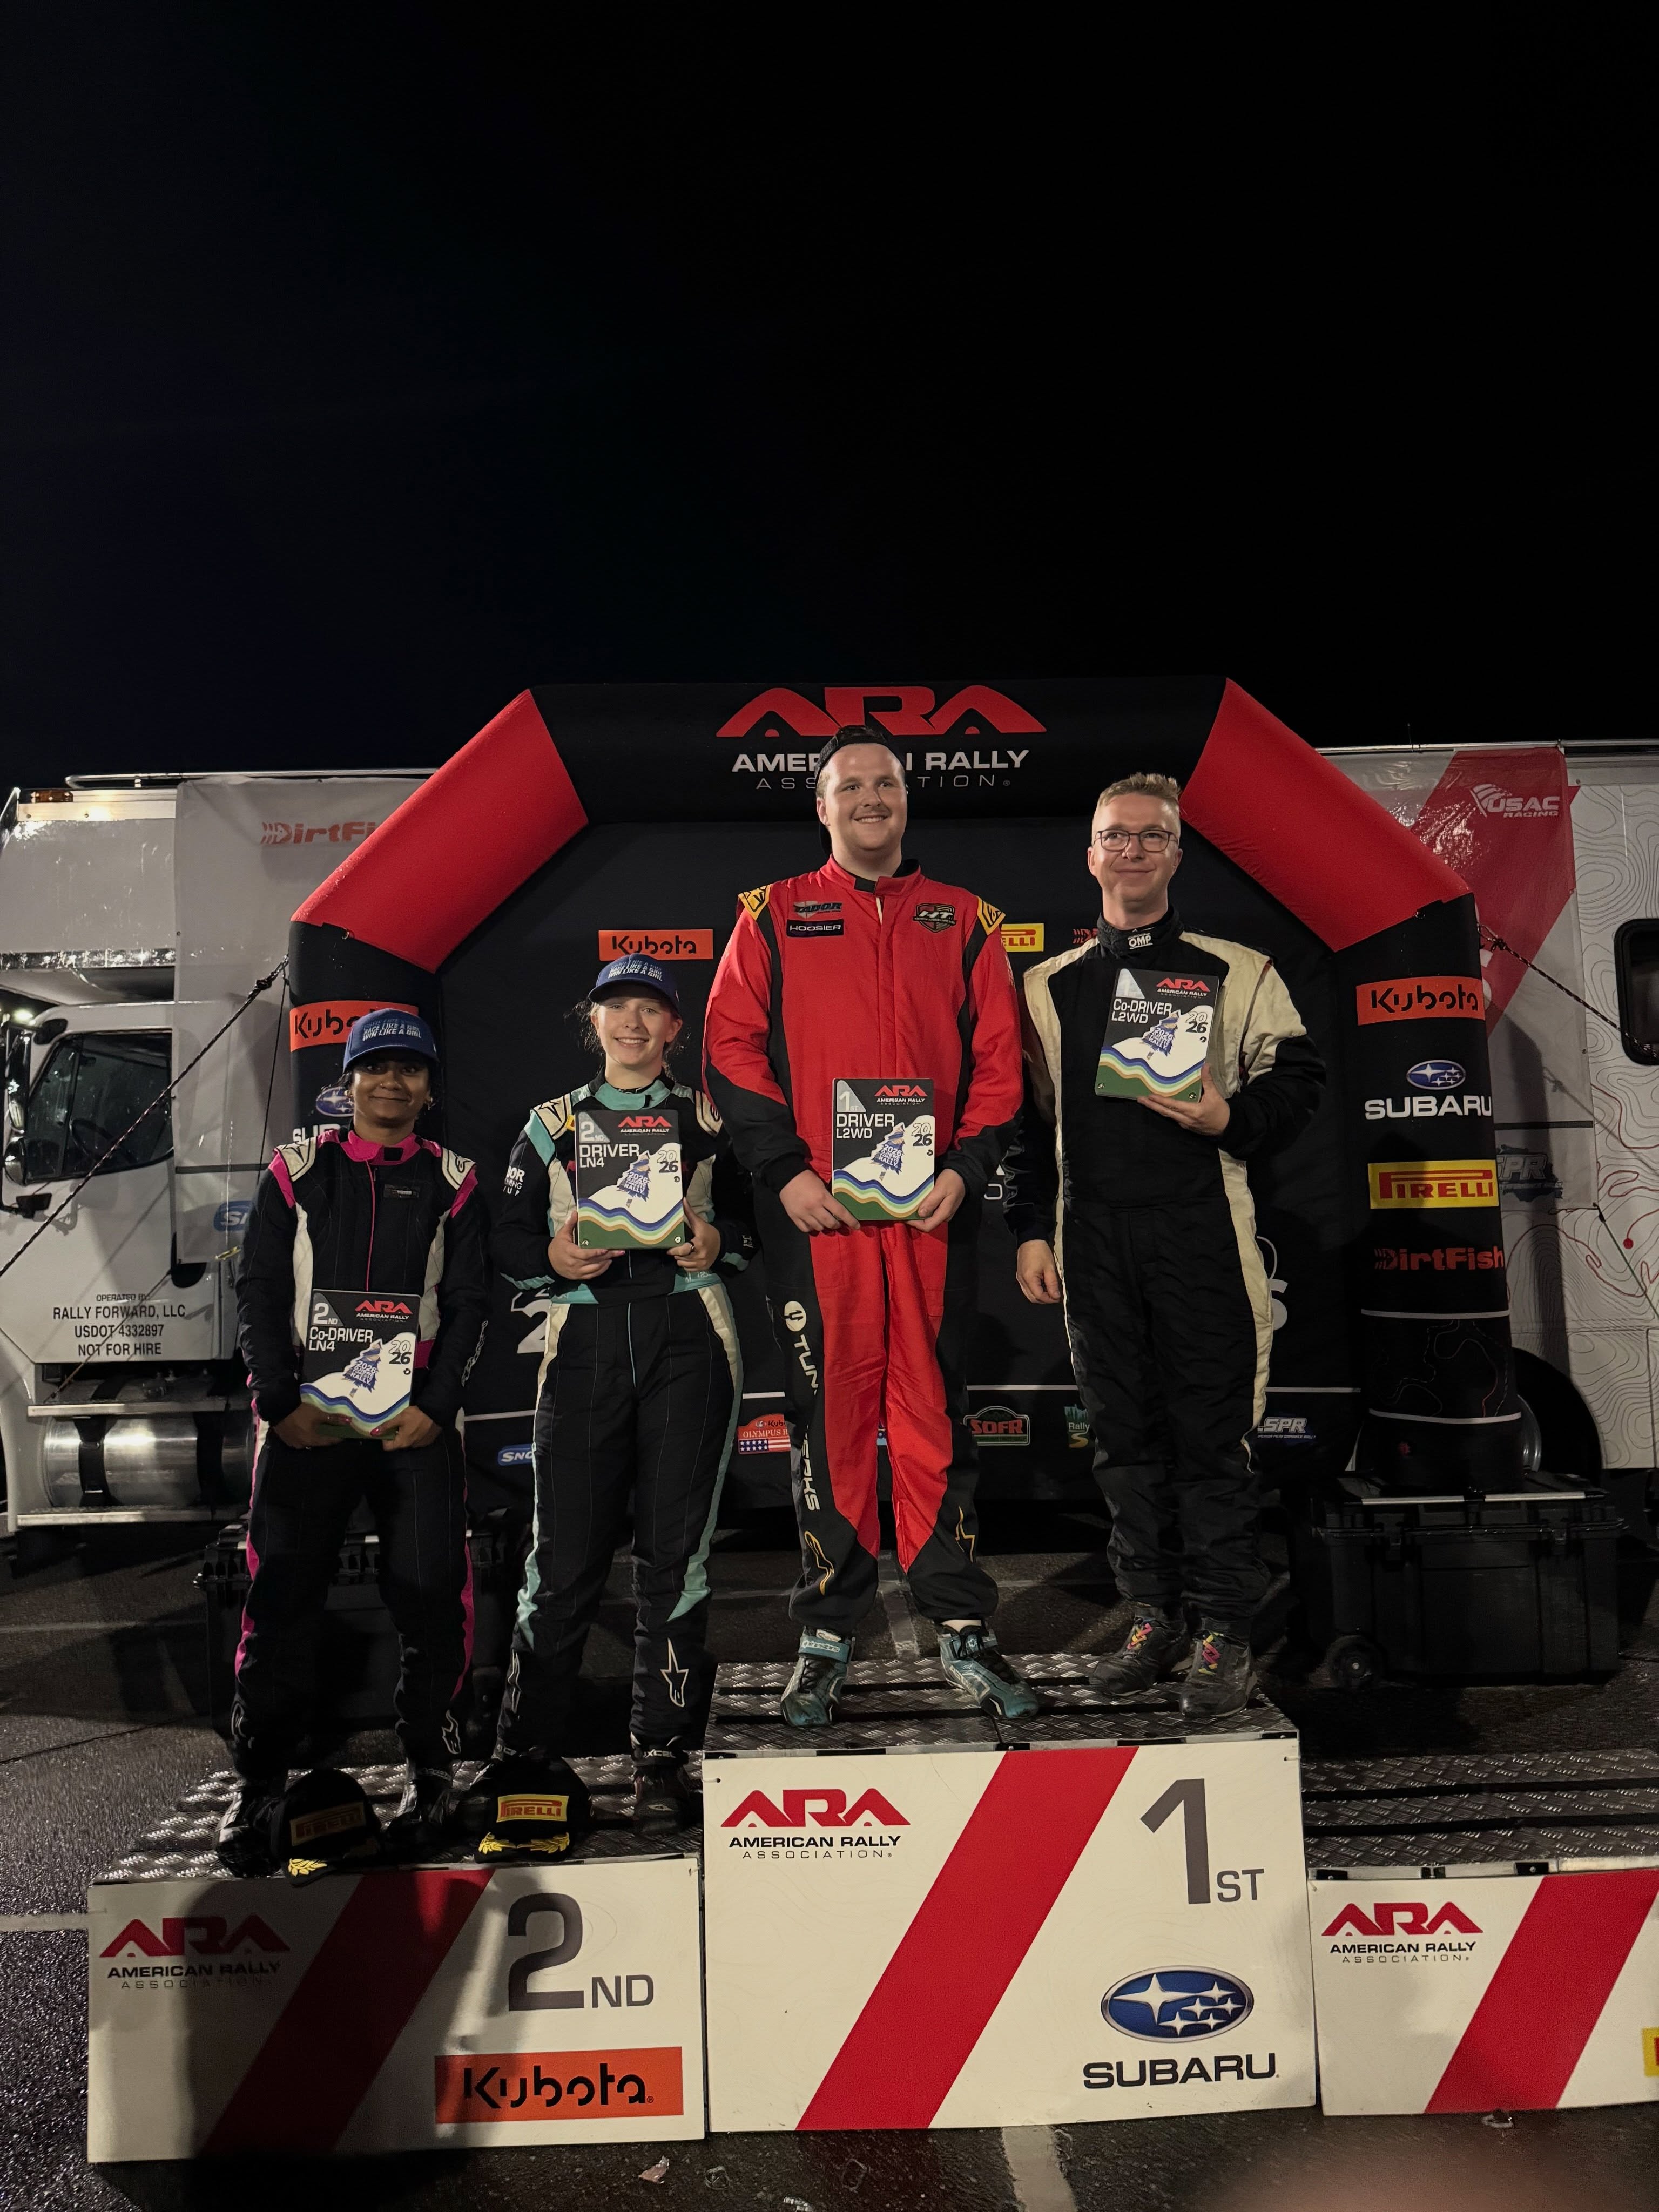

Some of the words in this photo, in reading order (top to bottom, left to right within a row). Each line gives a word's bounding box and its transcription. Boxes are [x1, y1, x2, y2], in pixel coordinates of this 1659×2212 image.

[716, 685, 1047, 738] ARA
[926, 750, 1029, 770] RALLY
[1487, 796, 1560, 812] USAC
[260, 821, 376, 844] DirtFi
[612, 935, 697, 954] Kubota
[1128, 935, 1152, 948] OMP
[1156, 977, 1210, 992] ARA
[1371, 984, 1479, 1013] Kubota
[1113, 999, 1172, 1015] Co-DRIVER
[1111, 1011, 1148, 1024] L2WD
[1186, 1011, 1208, 1023] 20
[1185, 1021, 1208, 1034] 26
[874, 1085, 928, 1097] ARA
[1364, 1095, 1492, 1120] SUBARU
[617, 1116, 673, 1128] ARA
[837, 1114, 895, 1127] DRIVER
[836, 1128, 873, 1139] L2WD
[912, 1123, 932, 1136] 20
[912, 1133, 933, 1146] 26
[579, 1143, 640, 1157] DRIVER
[657, 1150, 677, 1163] 20
[579, 1157, 604, 1168] LN4
[658, 1161, 678, 1173] 26
[1378, 1169, 1493, 1199] PIRELLI
[1373, 1245, 1505, 1271] DirtFish
[53, 1306, 91, 1319] RALLY
[95, 1305, 160, 1319] FORWARD,
[163, 1304, 186, 1317] LLC
[355, 1300, 413, 1314] ARA
[75, 1325, 115, 1338] USDOT
[118, 1324, 164, 1337] 4332897
[309, 1326, 373, 1343] Co-DRIVER
[78, 1344, 102, 1356] NOT
[106, 1344, 130, 1355] FOR
[134, 1343, 162, 1355] HIRE
[309, 1339, 335, 1352] LN4
[389, 1340, 411, 1353] 20
[389, 1351, 412, 1364] 26
[743, 1428, 781, 1438] OLYMPUS
[970, 1419, 1024, 1435] SOFR
[1068, 1422, 1090, 1432] Rally
[500, 1799, 562, 1818] PIRELLI
[720, 1788, 911, 1827] ARA
[729, 1836, 835, 1847] AMERICAN
[841, 1836, 901, 1847] RALLY
[743, 1850, 885, 1859] ASSOCIATION
[1321, 1901, 1483, 1936] ARA
[100, 1914, 291, 1958] ARA
[1330, 1942, 1420, 1954] AMERICAN
[1425, 1941, 1477, 1953] RALLY
[1341, 1954, 1462, 1963] ASSOCIATION
[108, 1965, 213, 1978] AMERICAN
[220, 1960, 281, 1974] RALLY
[1083, 2053, 1276, 2089] SUBARU
[463, 2062, 646, 2109] Kubota
